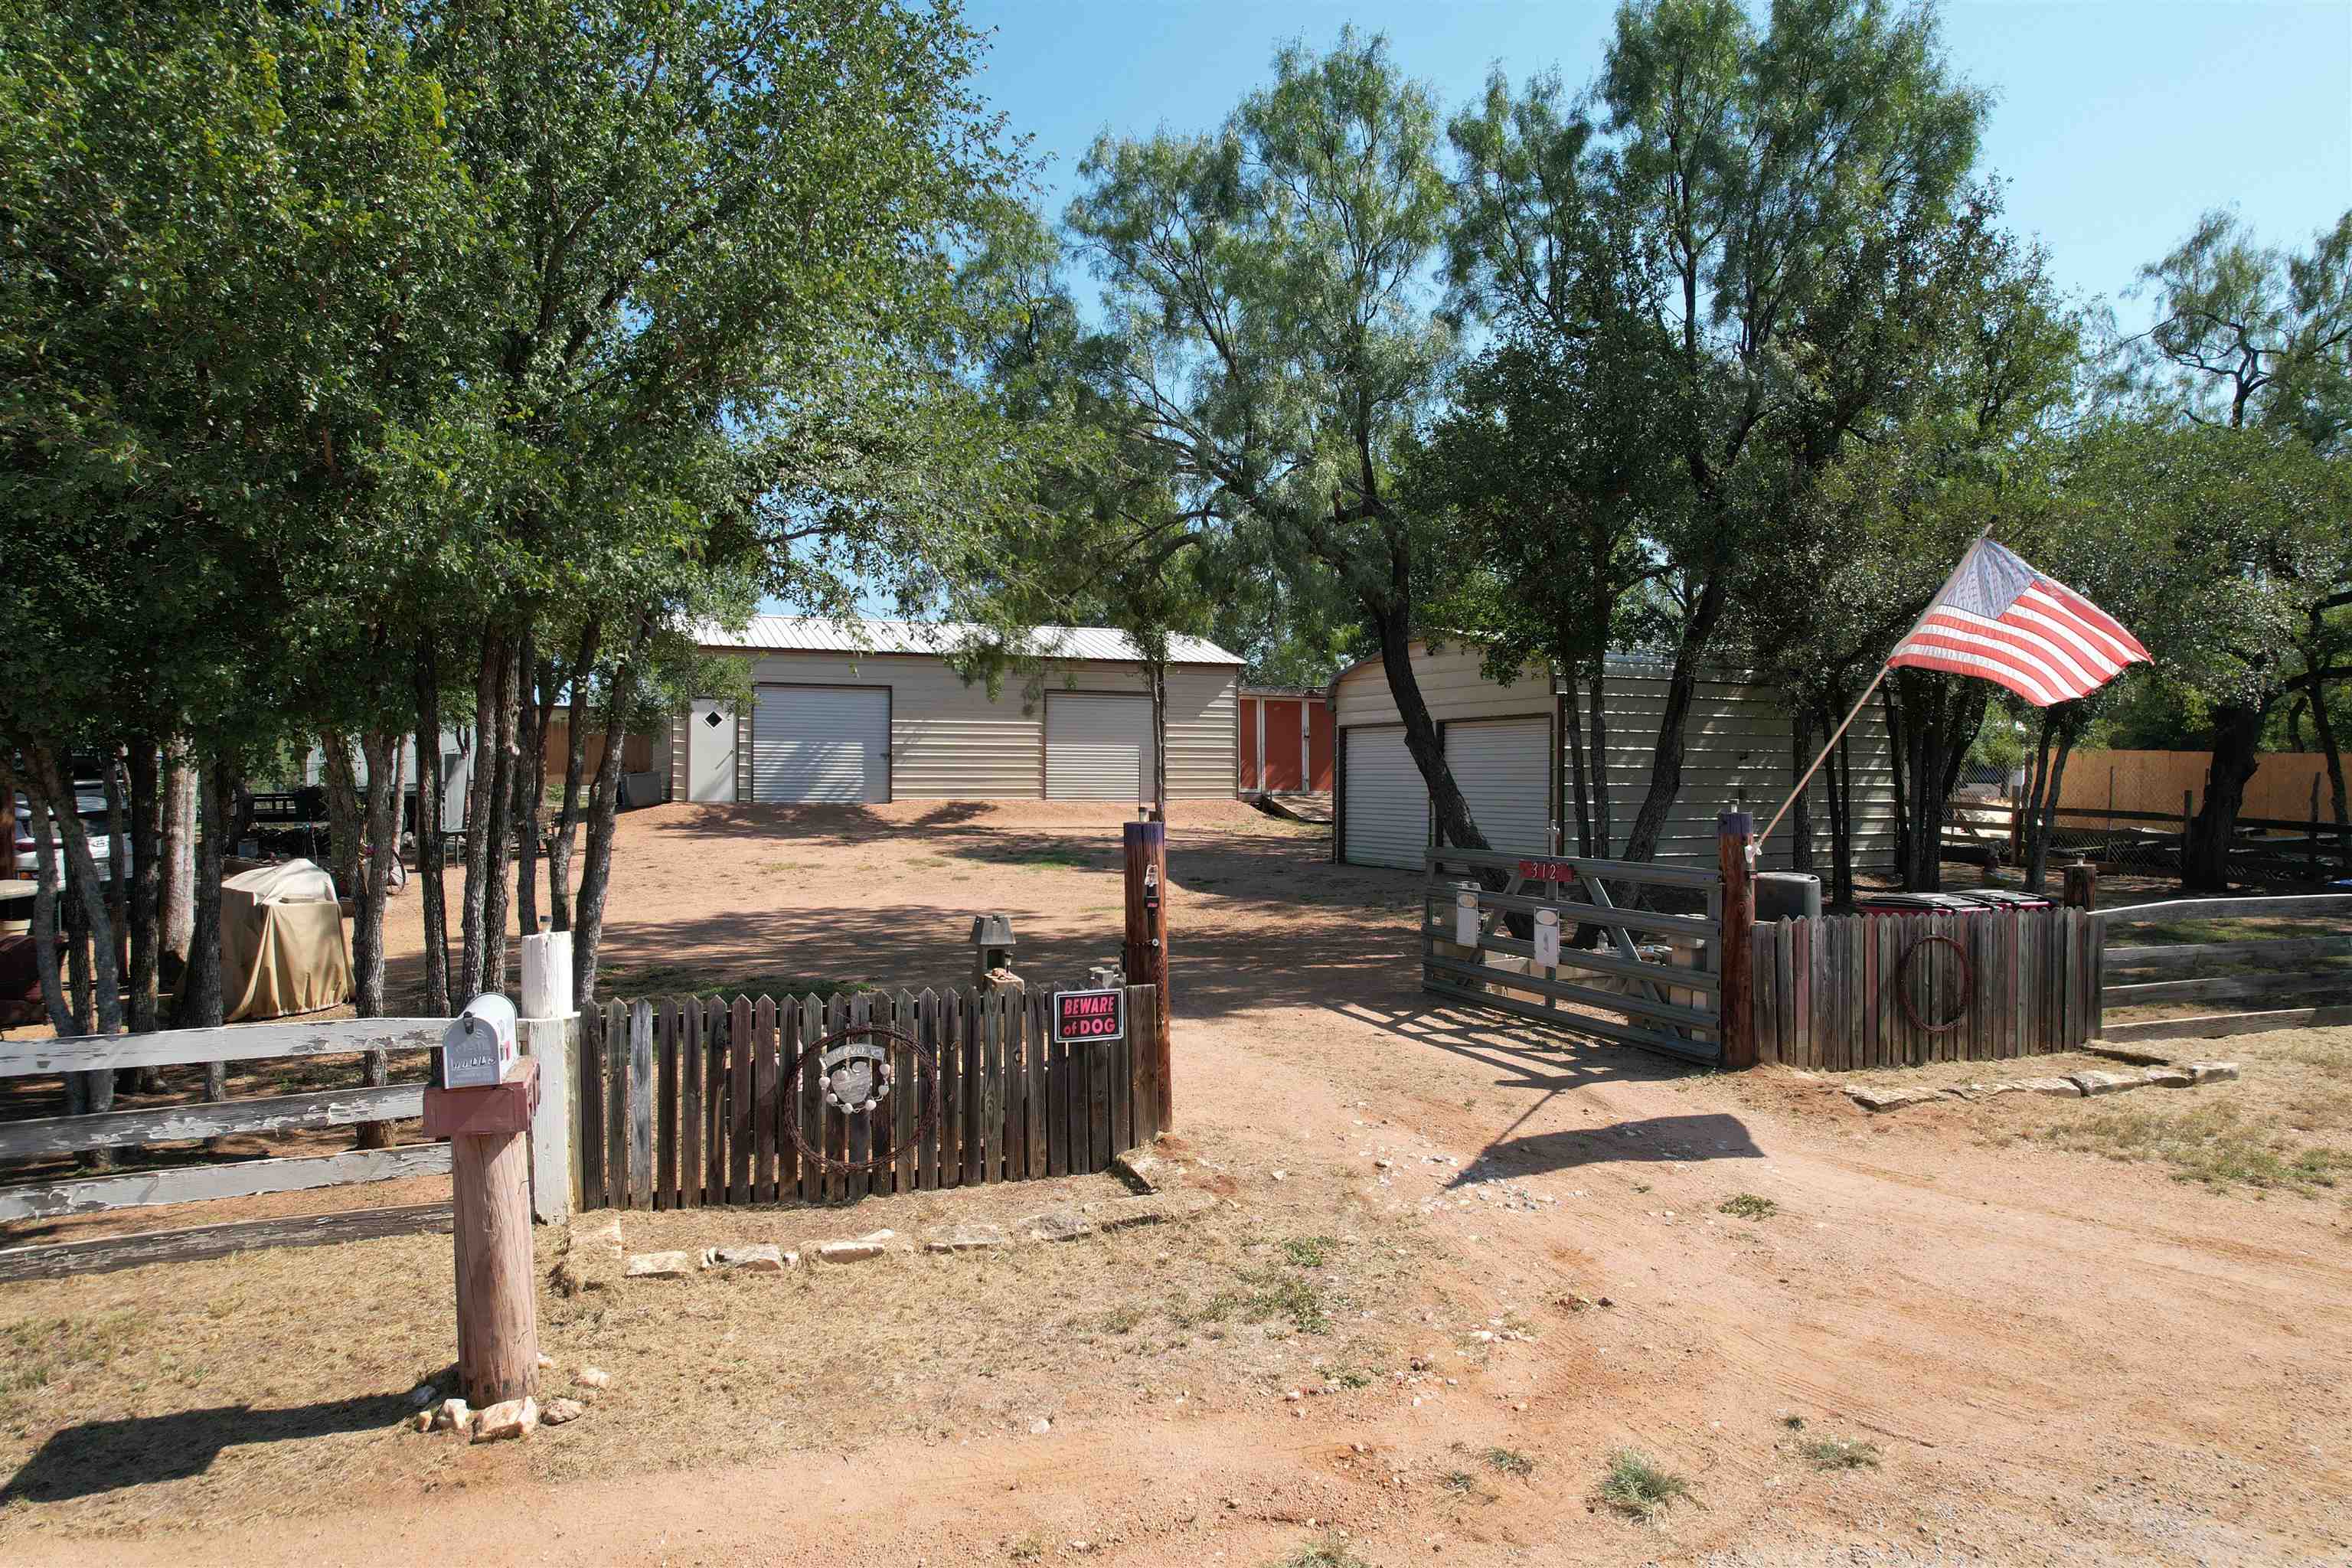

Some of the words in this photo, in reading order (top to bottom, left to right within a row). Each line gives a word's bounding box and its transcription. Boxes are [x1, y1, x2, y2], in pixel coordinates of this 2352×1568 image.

[1533, 862, 1557, 880] 312
[1063, 996, 1115, 1014] BEWARE
[1063, 1021, 1076, 1035] of
[1080, 1018, 1115, 1034] DOG
